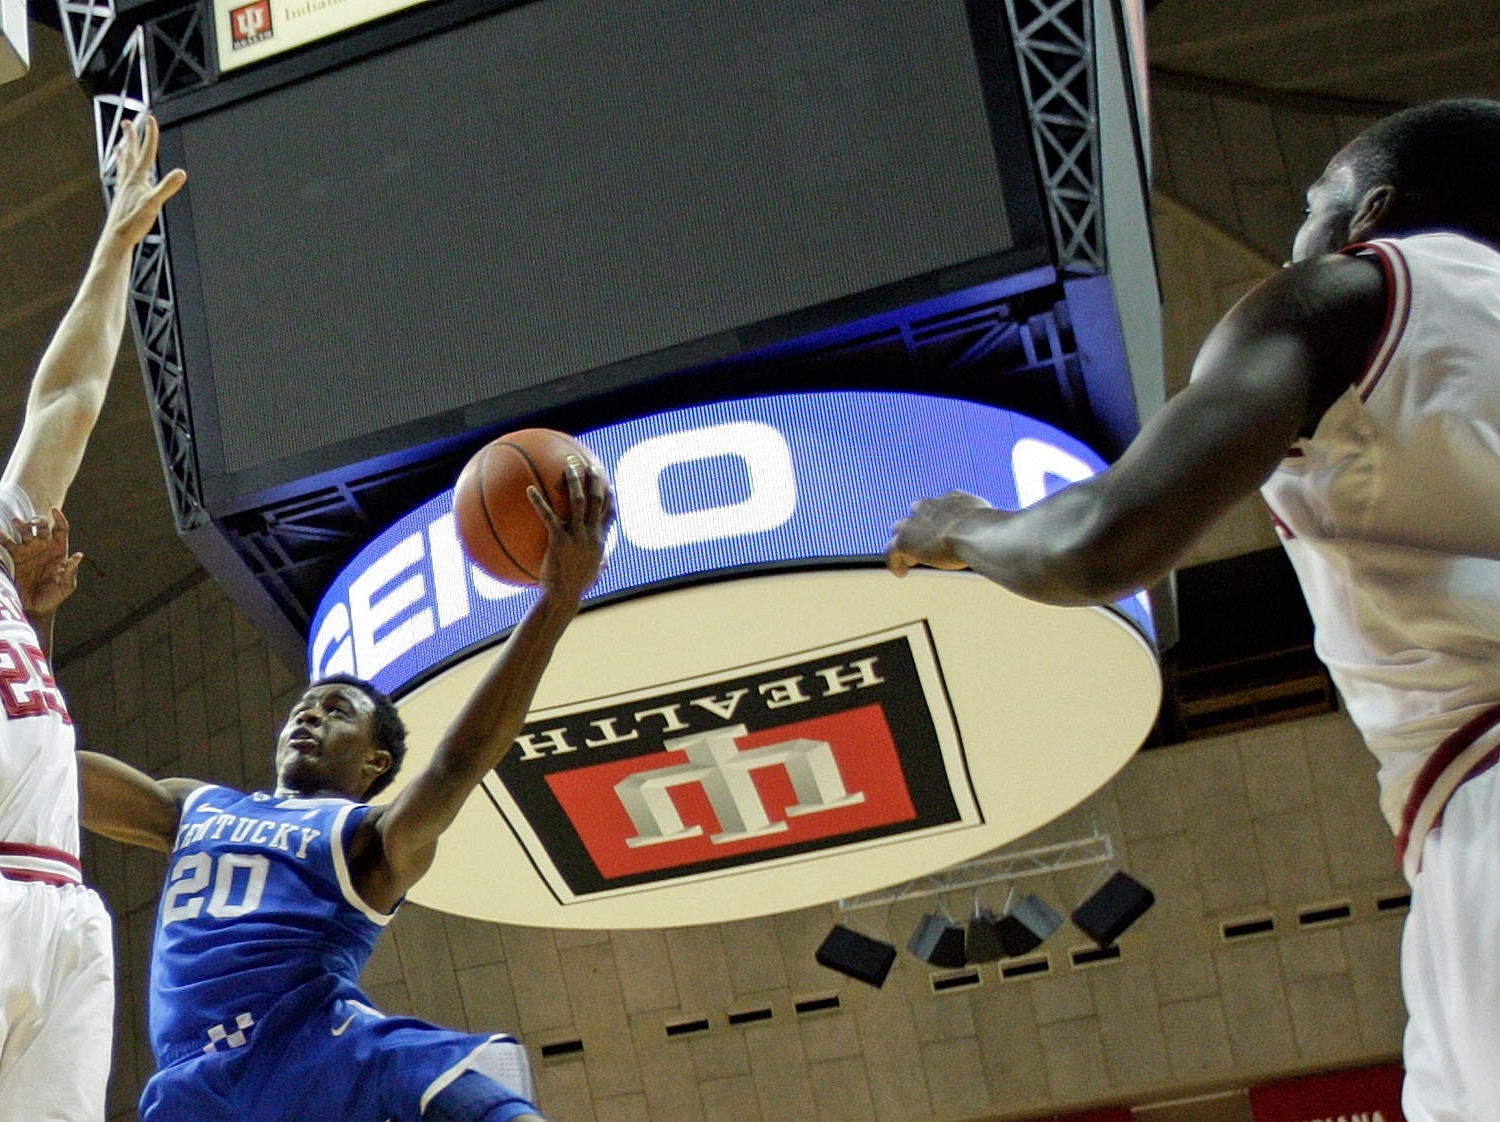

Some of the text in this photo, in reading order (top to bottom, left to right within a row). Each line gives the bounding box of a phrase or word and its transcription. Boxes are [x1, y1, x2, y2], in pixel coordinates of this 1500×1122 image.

[312, 420, 799, 685] GEIO
[514, 656, 886, 761] HEALTH
[162, 851, 270, 929] 20
